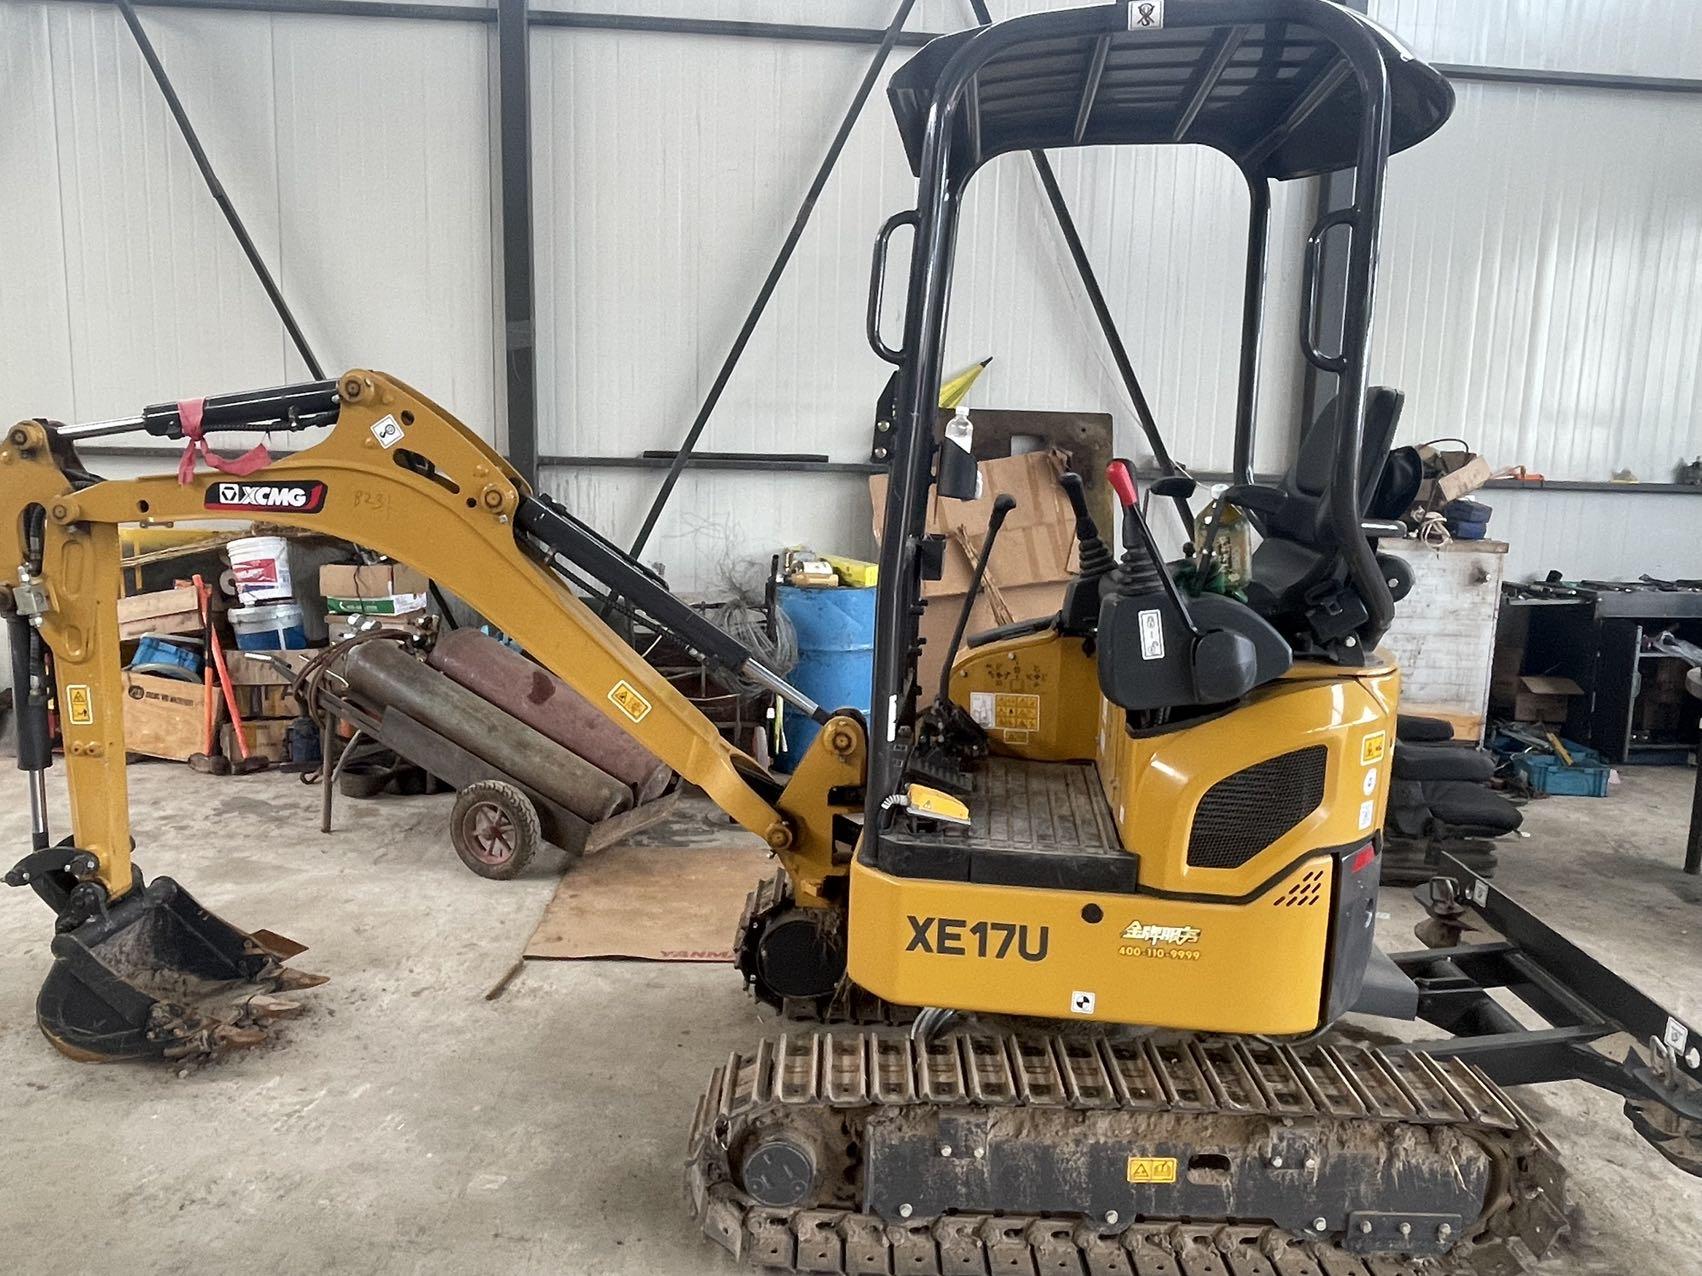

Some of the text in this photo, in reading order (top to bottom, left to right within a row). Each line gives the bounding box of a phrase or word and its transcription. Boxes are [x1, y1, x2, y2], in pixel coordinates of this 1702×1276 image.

[241, 486, 307, 507] XCMG
[905, 915, 1049, 962] XE17U
[1118, 946, 1200, 960] 400-110-9999
